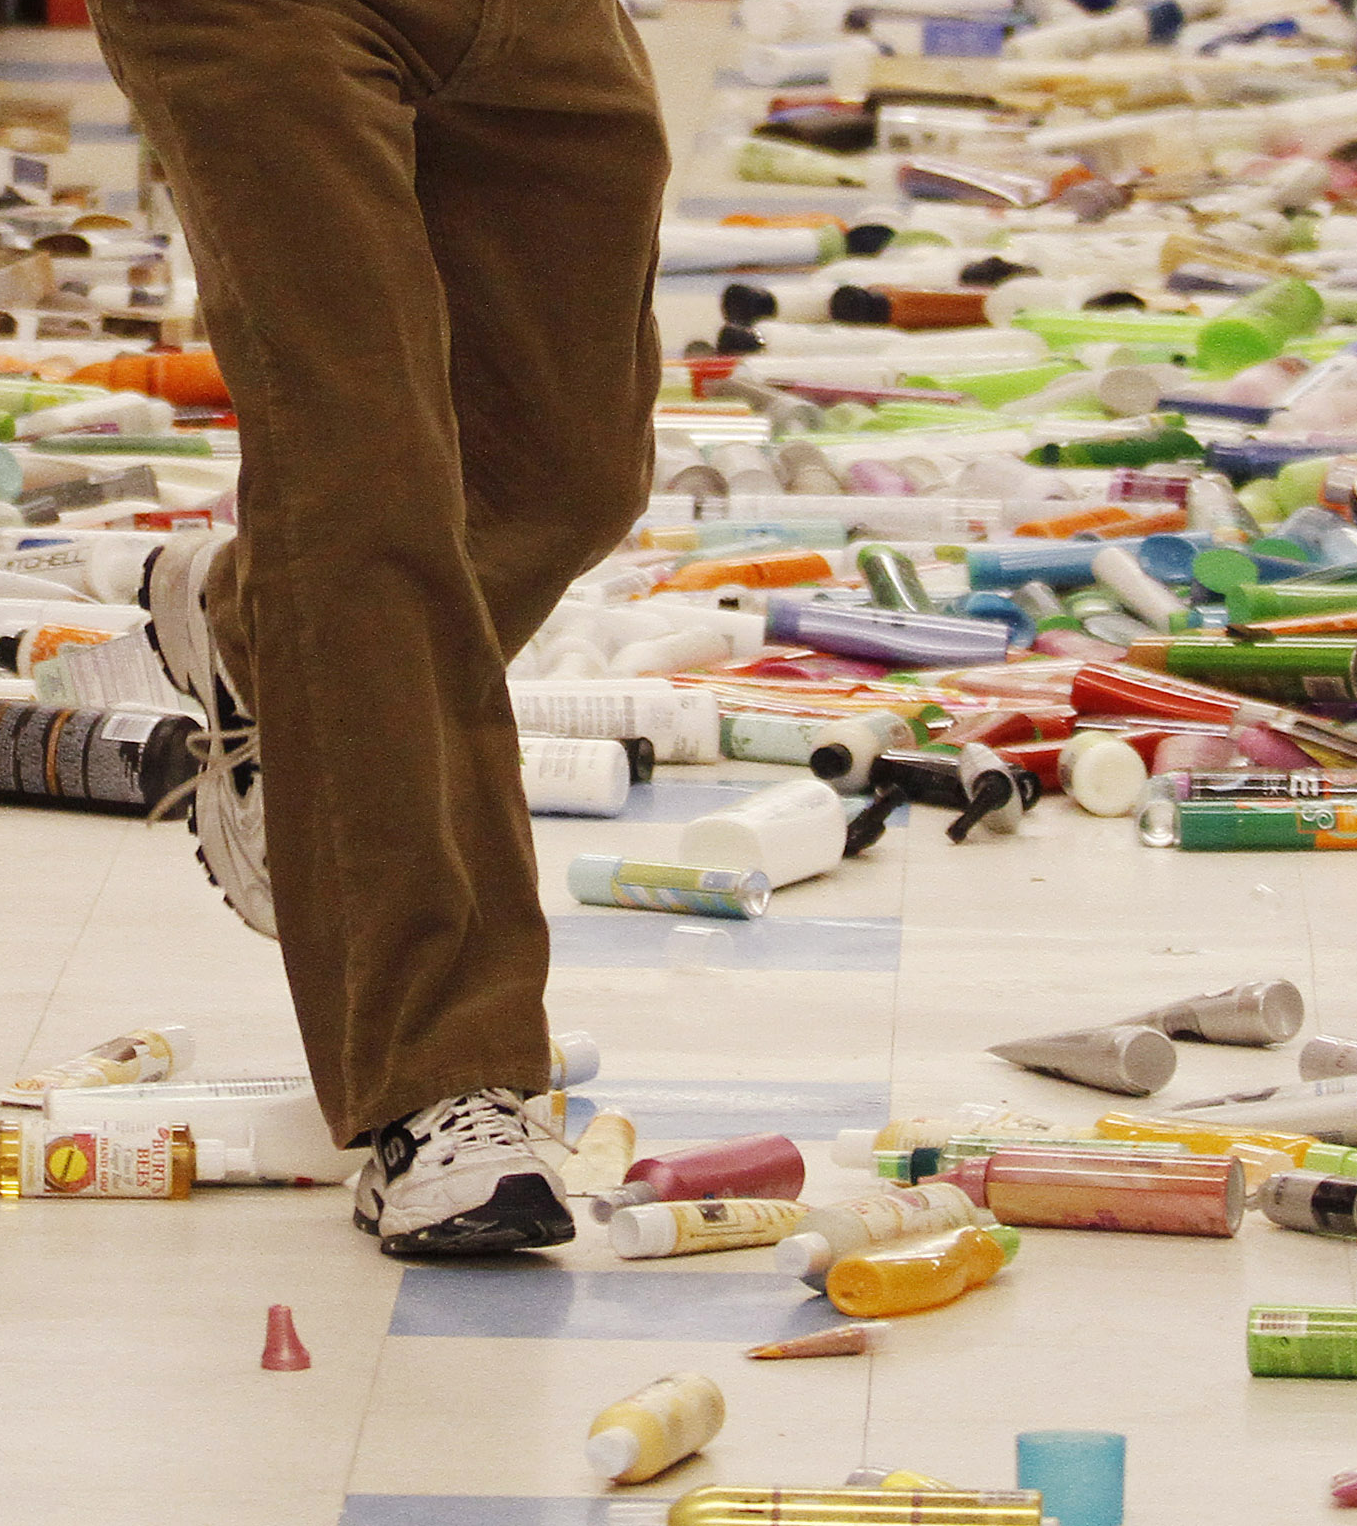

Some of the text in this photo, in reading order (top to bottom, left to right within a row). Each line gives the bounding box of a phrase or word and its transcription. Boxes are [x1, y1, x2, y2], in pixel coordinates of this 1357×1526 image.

[99, 1138, 109, 1167] HAND
[137, 1148, 150, 1187] BEES
[151, 1138, 166, 1194] BURT'S
